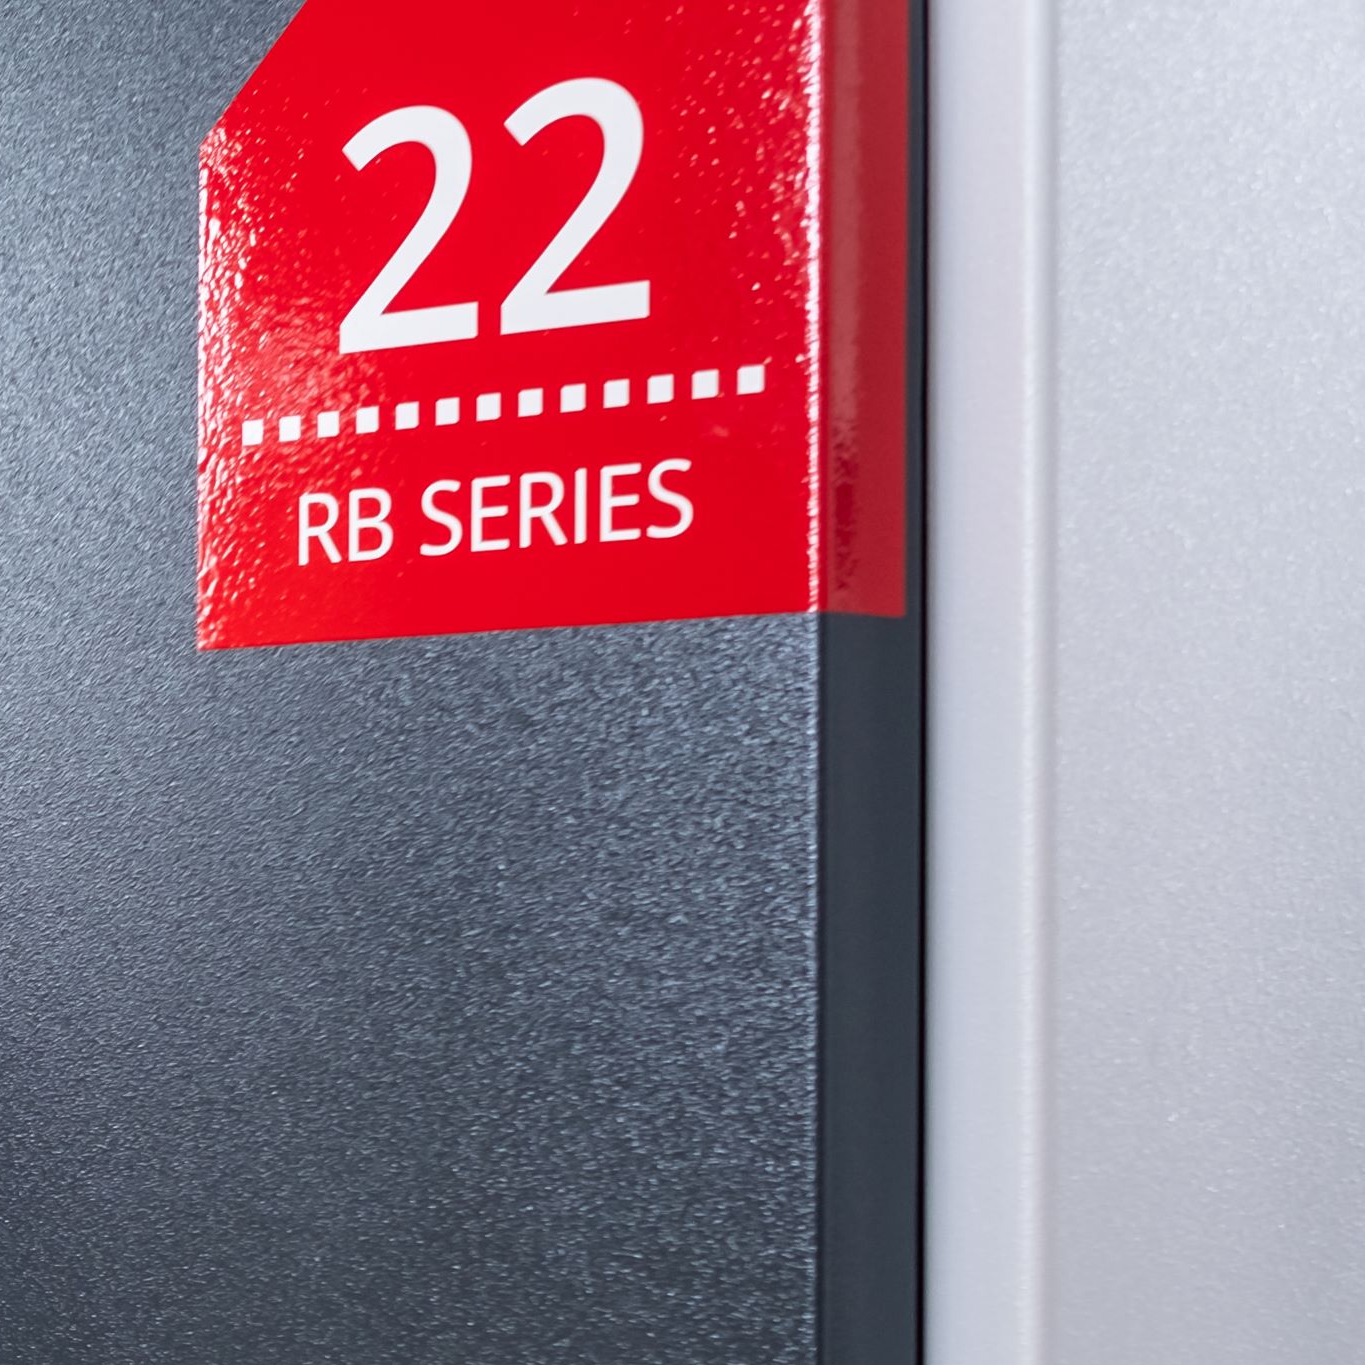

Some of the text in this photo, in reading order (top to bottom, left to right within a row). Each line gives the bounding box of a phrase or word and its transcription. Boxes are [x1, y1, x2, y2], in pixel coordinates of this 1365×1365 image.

[339, 77, 651, 354] 22
[297, 458, 695, 566] RB SERIES
